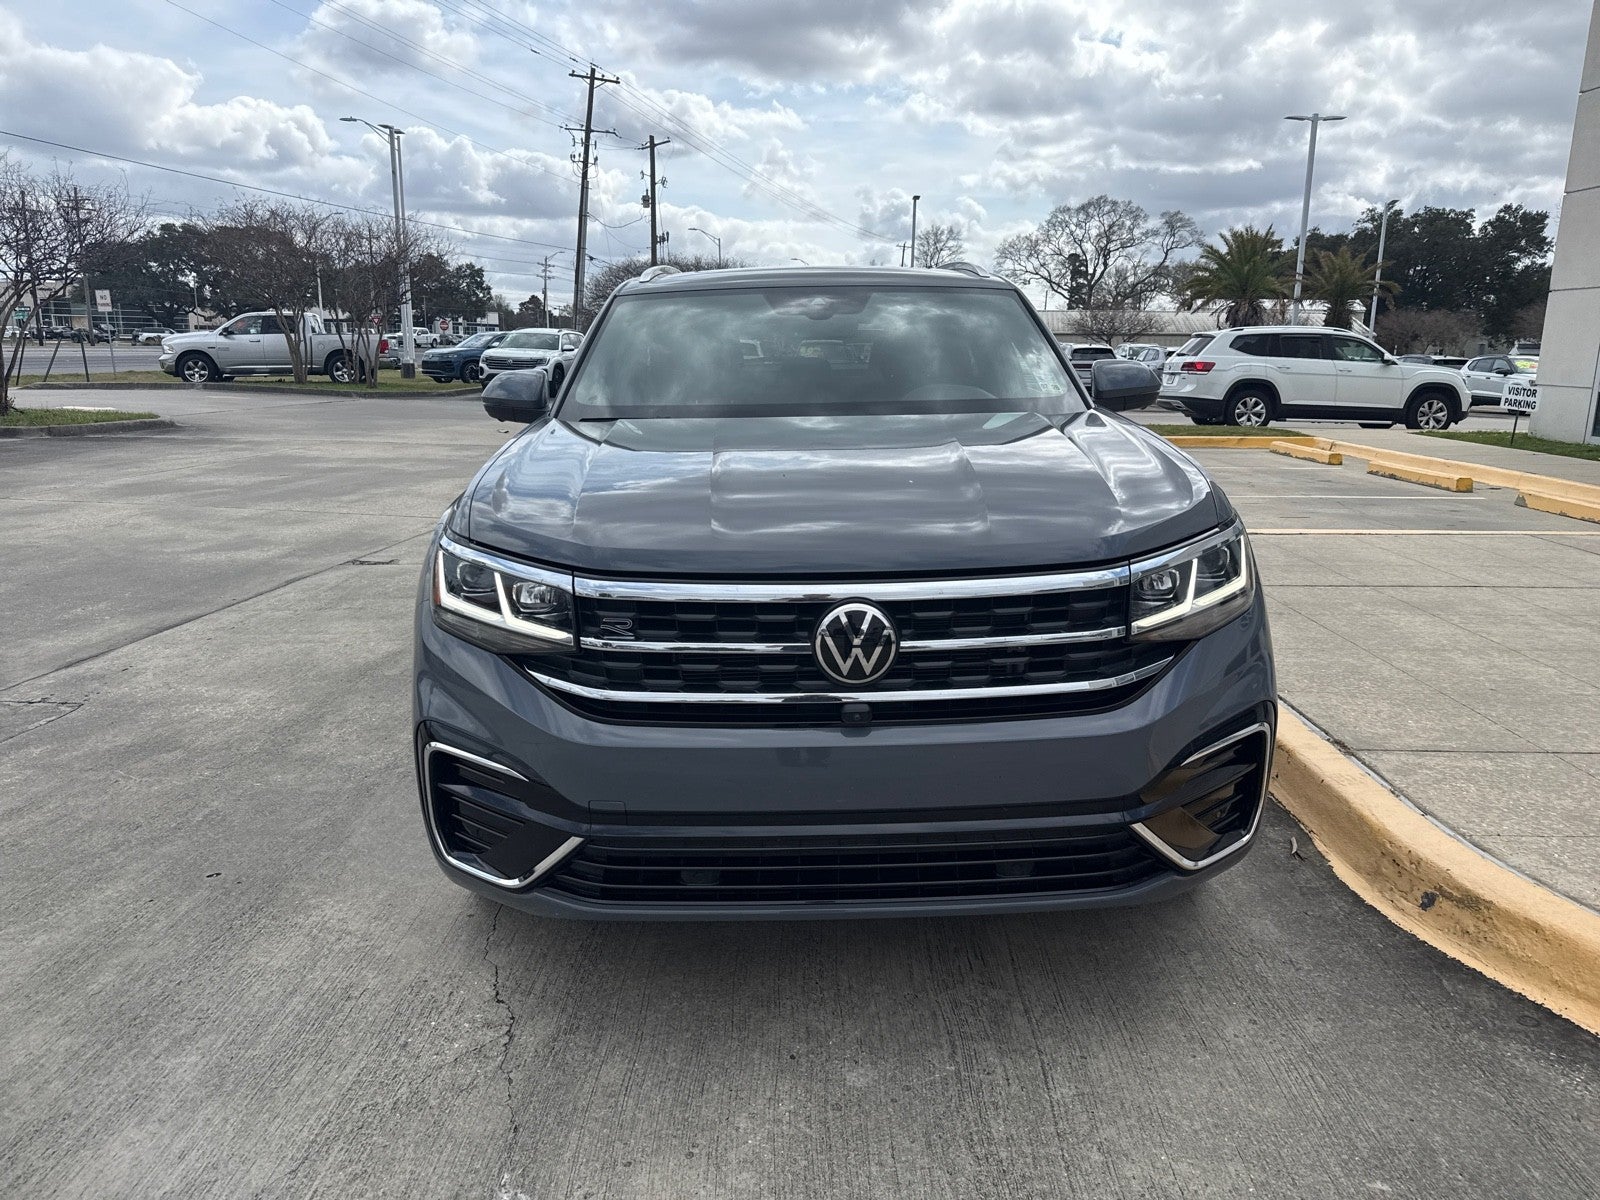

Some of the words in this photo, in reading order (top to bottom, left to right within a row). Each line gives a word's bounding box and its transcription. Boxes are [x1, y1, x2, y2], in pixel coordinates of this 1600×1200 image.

[1508, 386, 1538, 398] VISITOR
[1503, 398, 1537, 410] PARKING
[818, 606, 894, 679] VW
